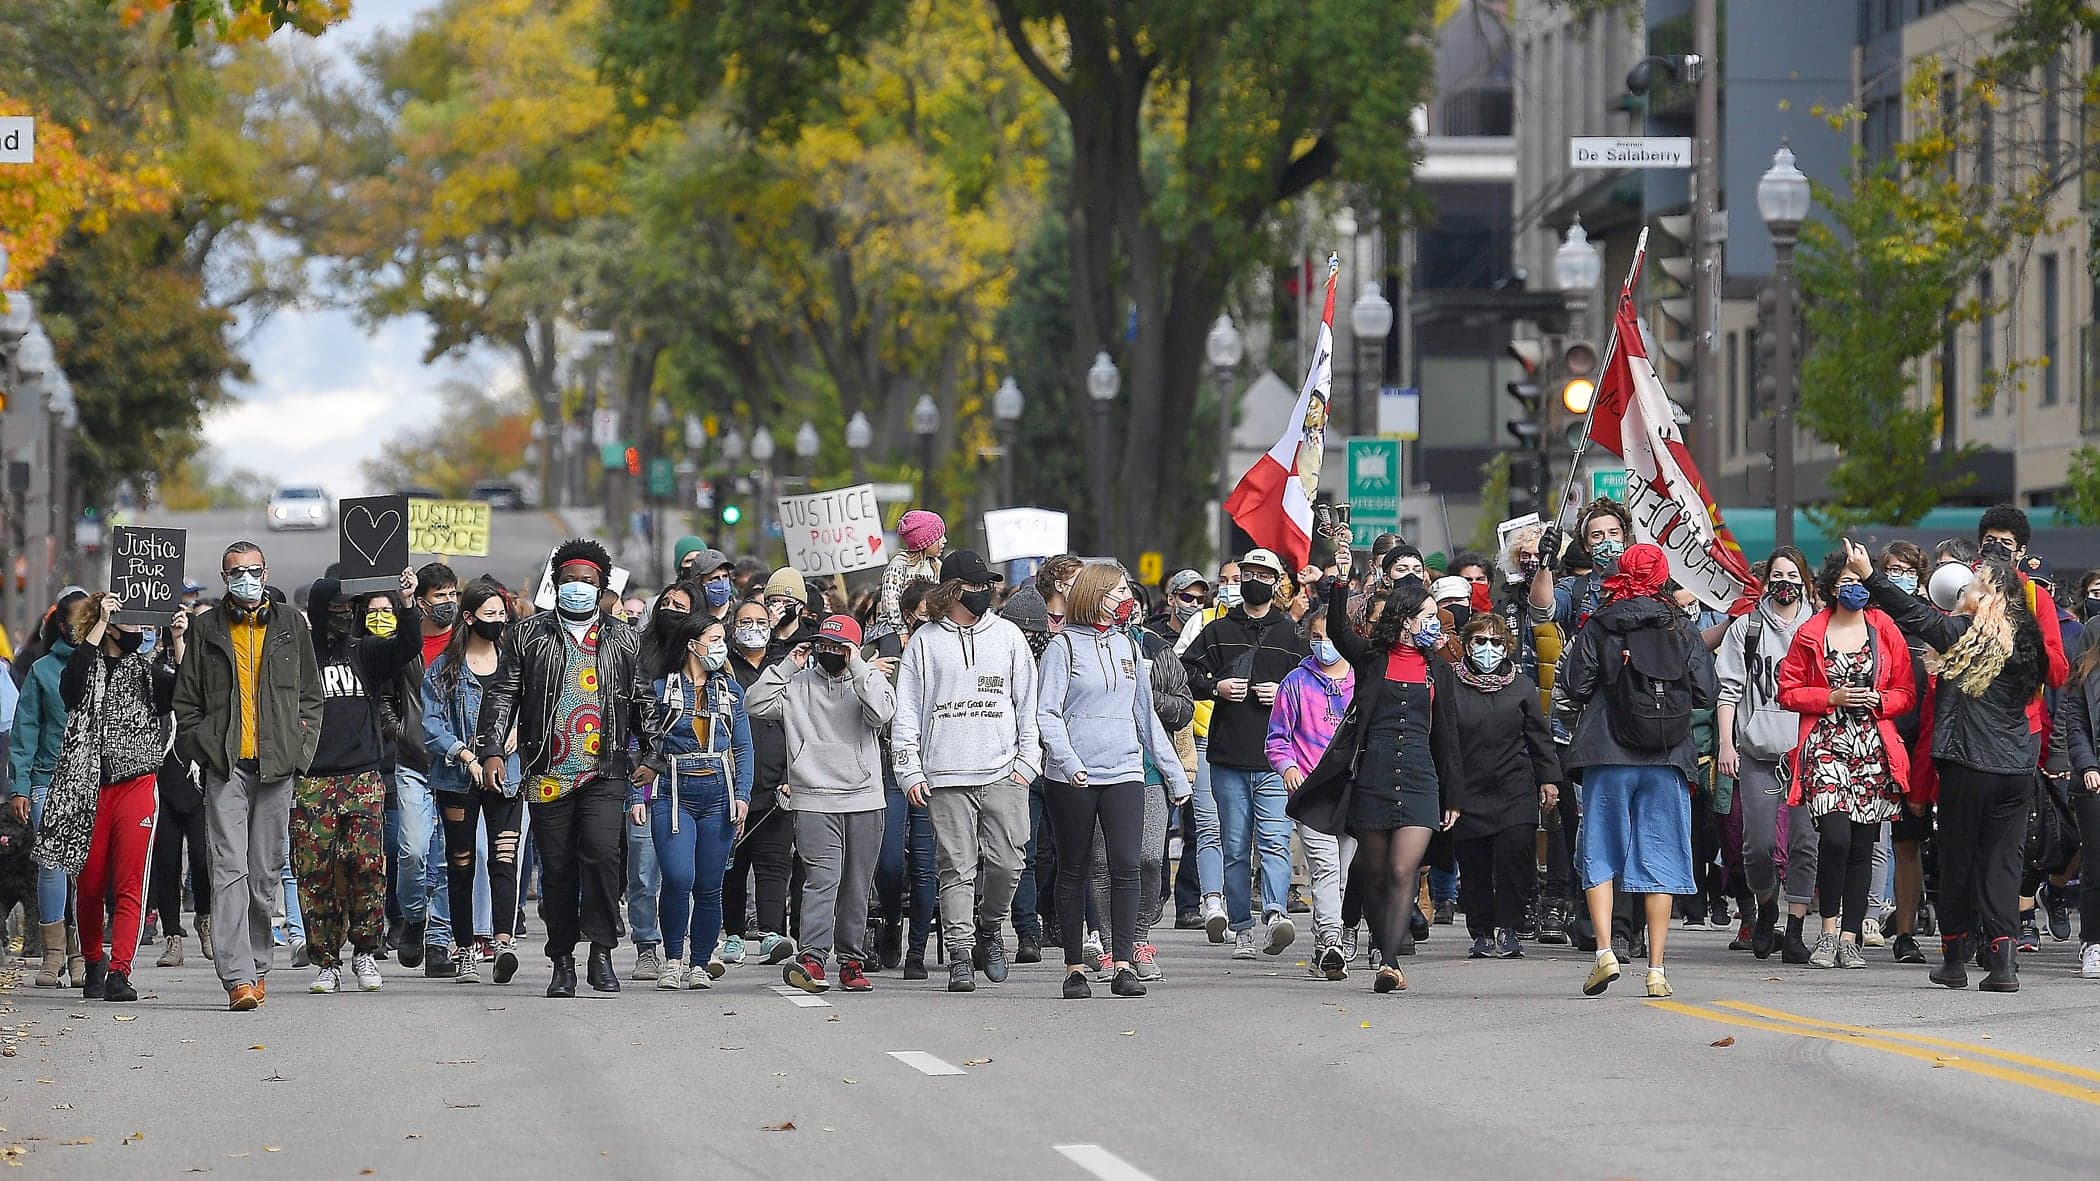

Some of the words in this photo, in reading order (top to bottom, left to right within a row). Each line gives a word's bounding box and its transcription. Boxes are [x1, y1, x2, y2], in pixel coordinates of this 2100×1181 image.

[0, 129, 19, 151] d
[1578, 149, 1599, 161] De
[1606, 149, 1681, 165] Salaberry
[409, 503, 487, 526] JUSTICE
[782, 490, 874, 528] JUSTICE
[411, 526, 483, 552] JOYCE
[810, 525, 858, 547] POUR
[798, 544, 867, 572] JOYCE
